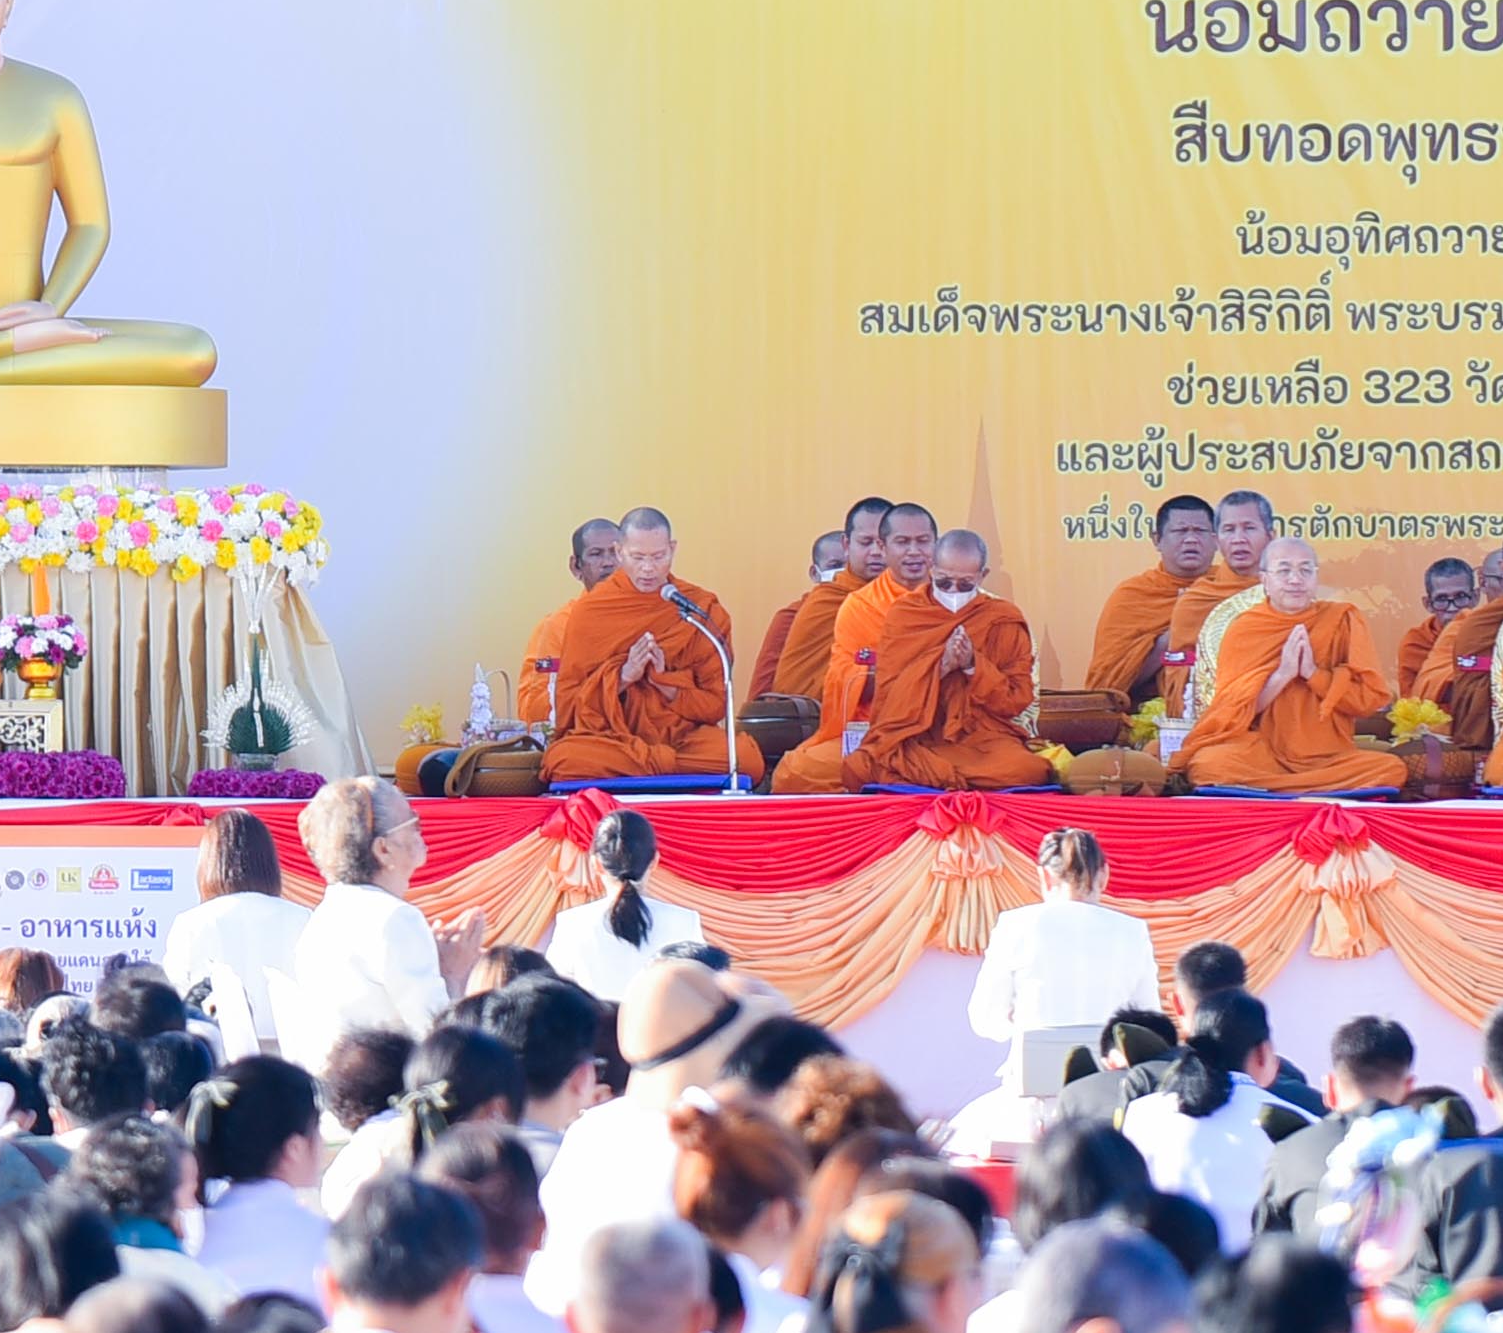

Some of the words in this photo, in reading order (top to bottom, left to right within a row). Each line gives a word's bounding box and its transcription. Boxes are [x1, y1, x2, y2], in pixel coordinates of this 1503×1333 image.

[860, 270, 1333, 334] สมเด็จพระนางเจ้าสิริกิติ์
[1167, 358, 1349, 406] ช่วยเหลือ
[1363, 369, 1452, 405] 323
[21, 907, 157, 939] อาหารแห้ง
